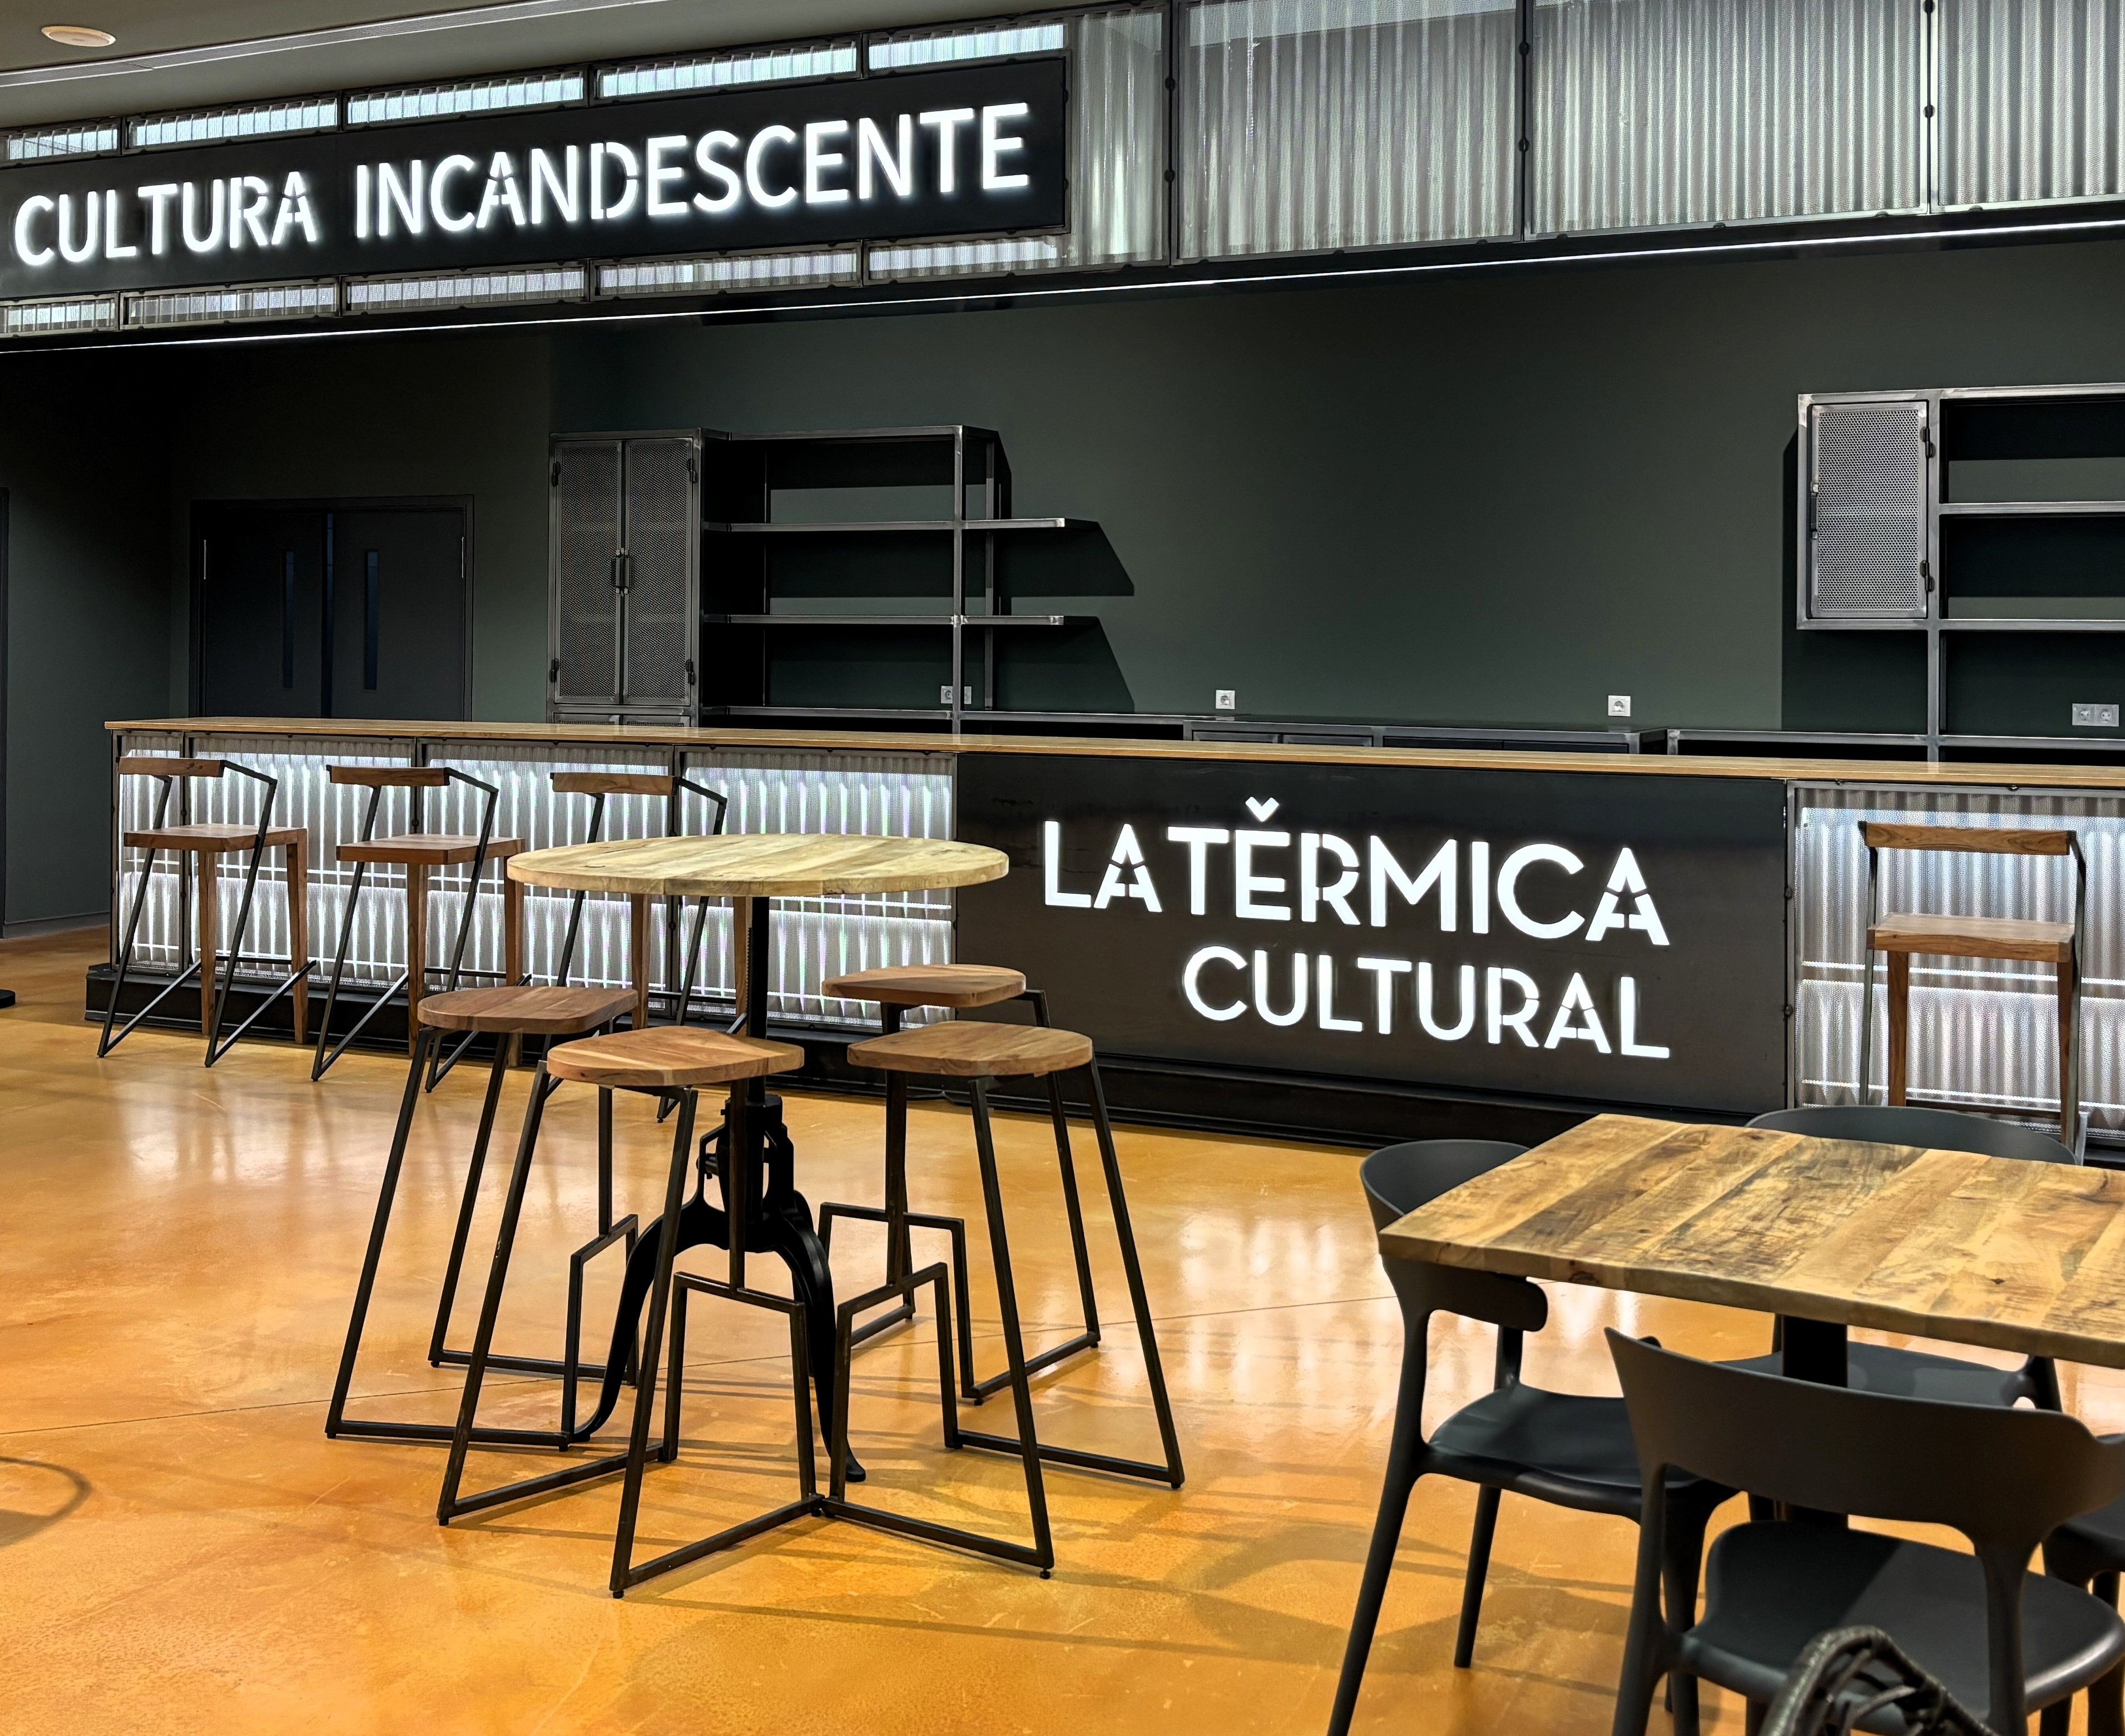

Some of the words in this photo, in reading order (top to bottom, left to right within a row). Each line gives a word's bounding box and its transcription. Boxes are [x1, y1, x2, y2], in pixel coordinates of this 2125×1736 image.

[14, 171, 319, 268] CULTURA
[356, 102, 1029, 239] INCANDESCENTE
[1044, 820, 1162, 913] LA
[1183, 946, 1670, 1059] CULTURAL
